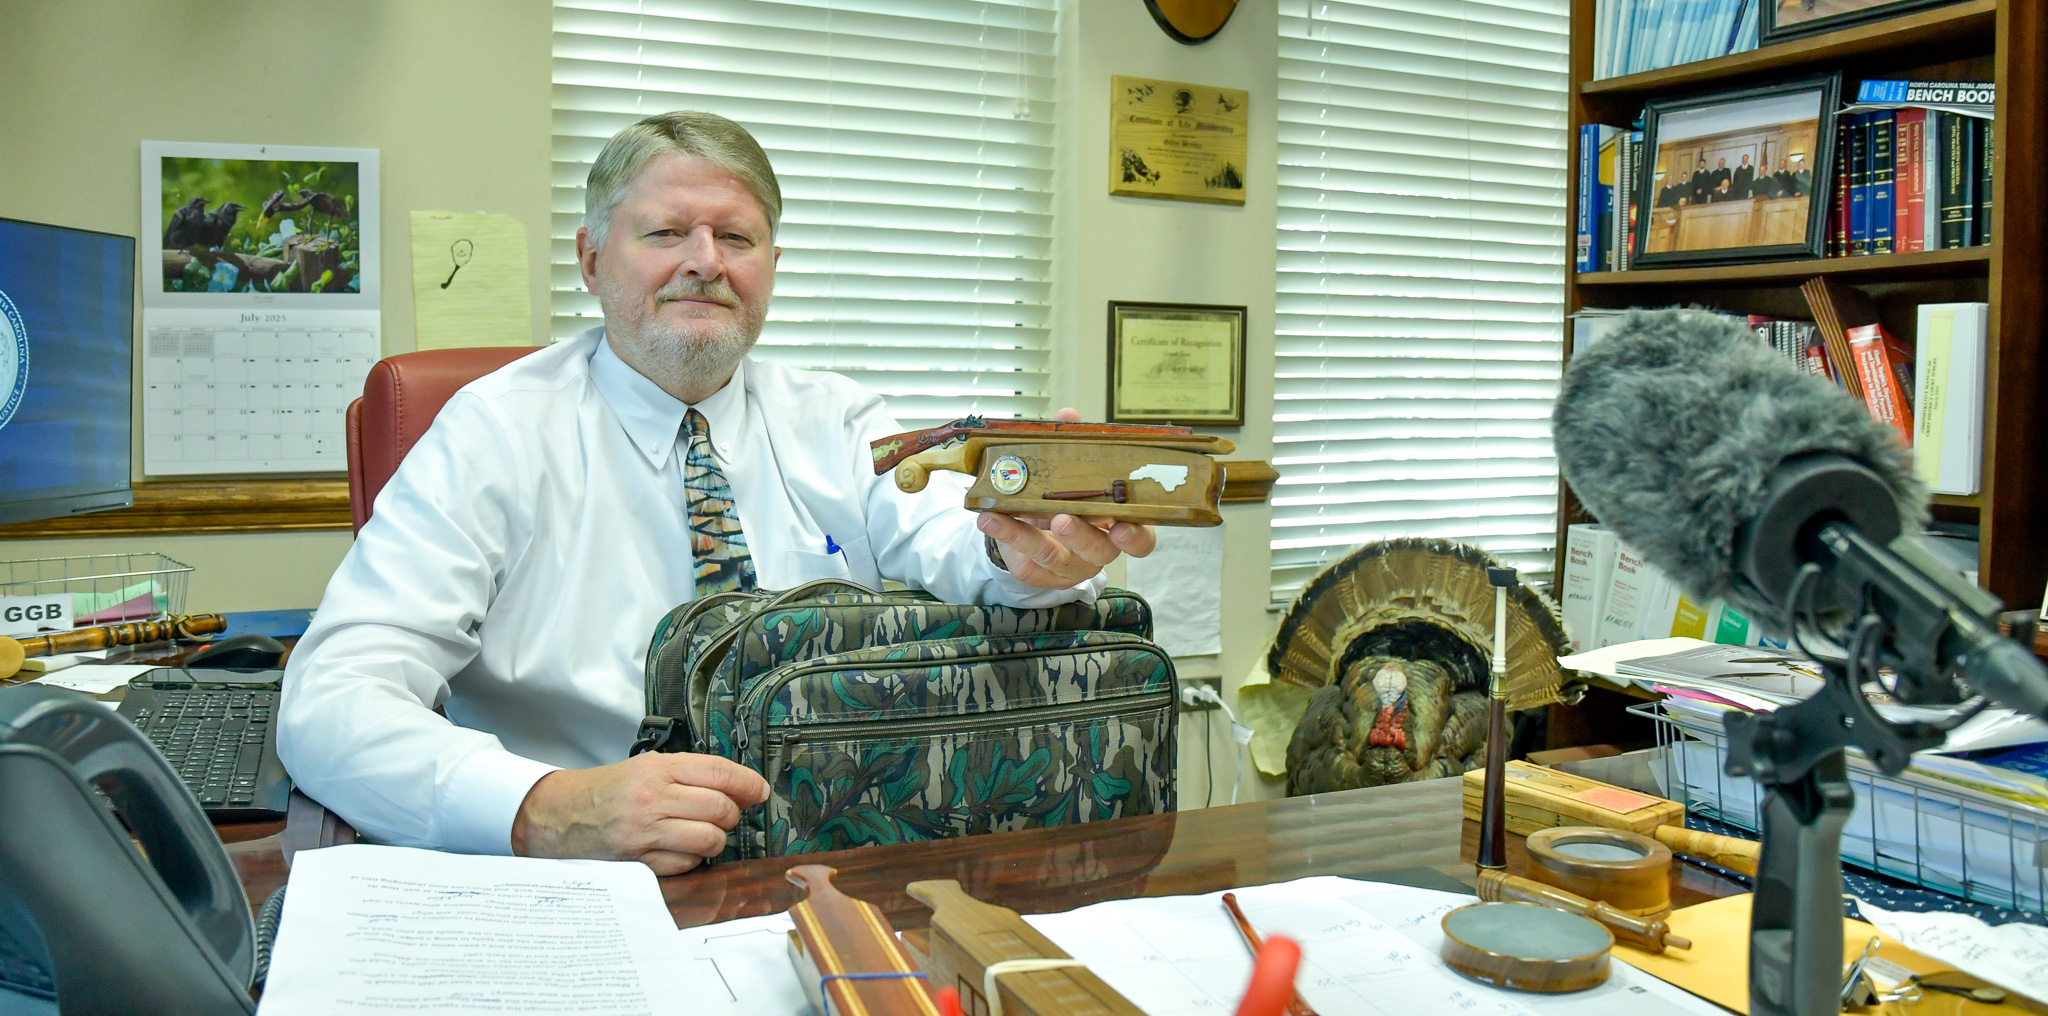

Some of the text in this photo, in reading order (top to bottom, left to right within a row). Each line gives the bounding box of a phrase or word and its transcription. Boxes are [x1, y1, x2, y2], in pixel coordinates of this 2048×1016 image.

[1959, 82, 1975, 90] TRIAL
[1906, 89, 1954, 102] BENCH
[1926, 139, 1935, 190] Digital Evidence
[240, 313, 286, 323] July 2025
[8, 310, 26, 364] CAROLINA
[1130, 336, 1223, 349] Certificate of Recognition
[1861, 351, 1872, 383] Proceedings
[1870, 389, 1878, 405] North
[1870, 361, 1881, 392] Termination
[1879, 397, 1889, 419] Parental
[1879, 366, 1887, 388] Neglect,
[1884, 388, 1895, 420] Dependency,
[1570, 547, 1593, 559] Bench
[1570, 556, 1588, 567] Book
[1620, 553, 1643, 568] Bench
[1618, 562, 1637, 575] Book
[4, 603, 62, 623] GGB
